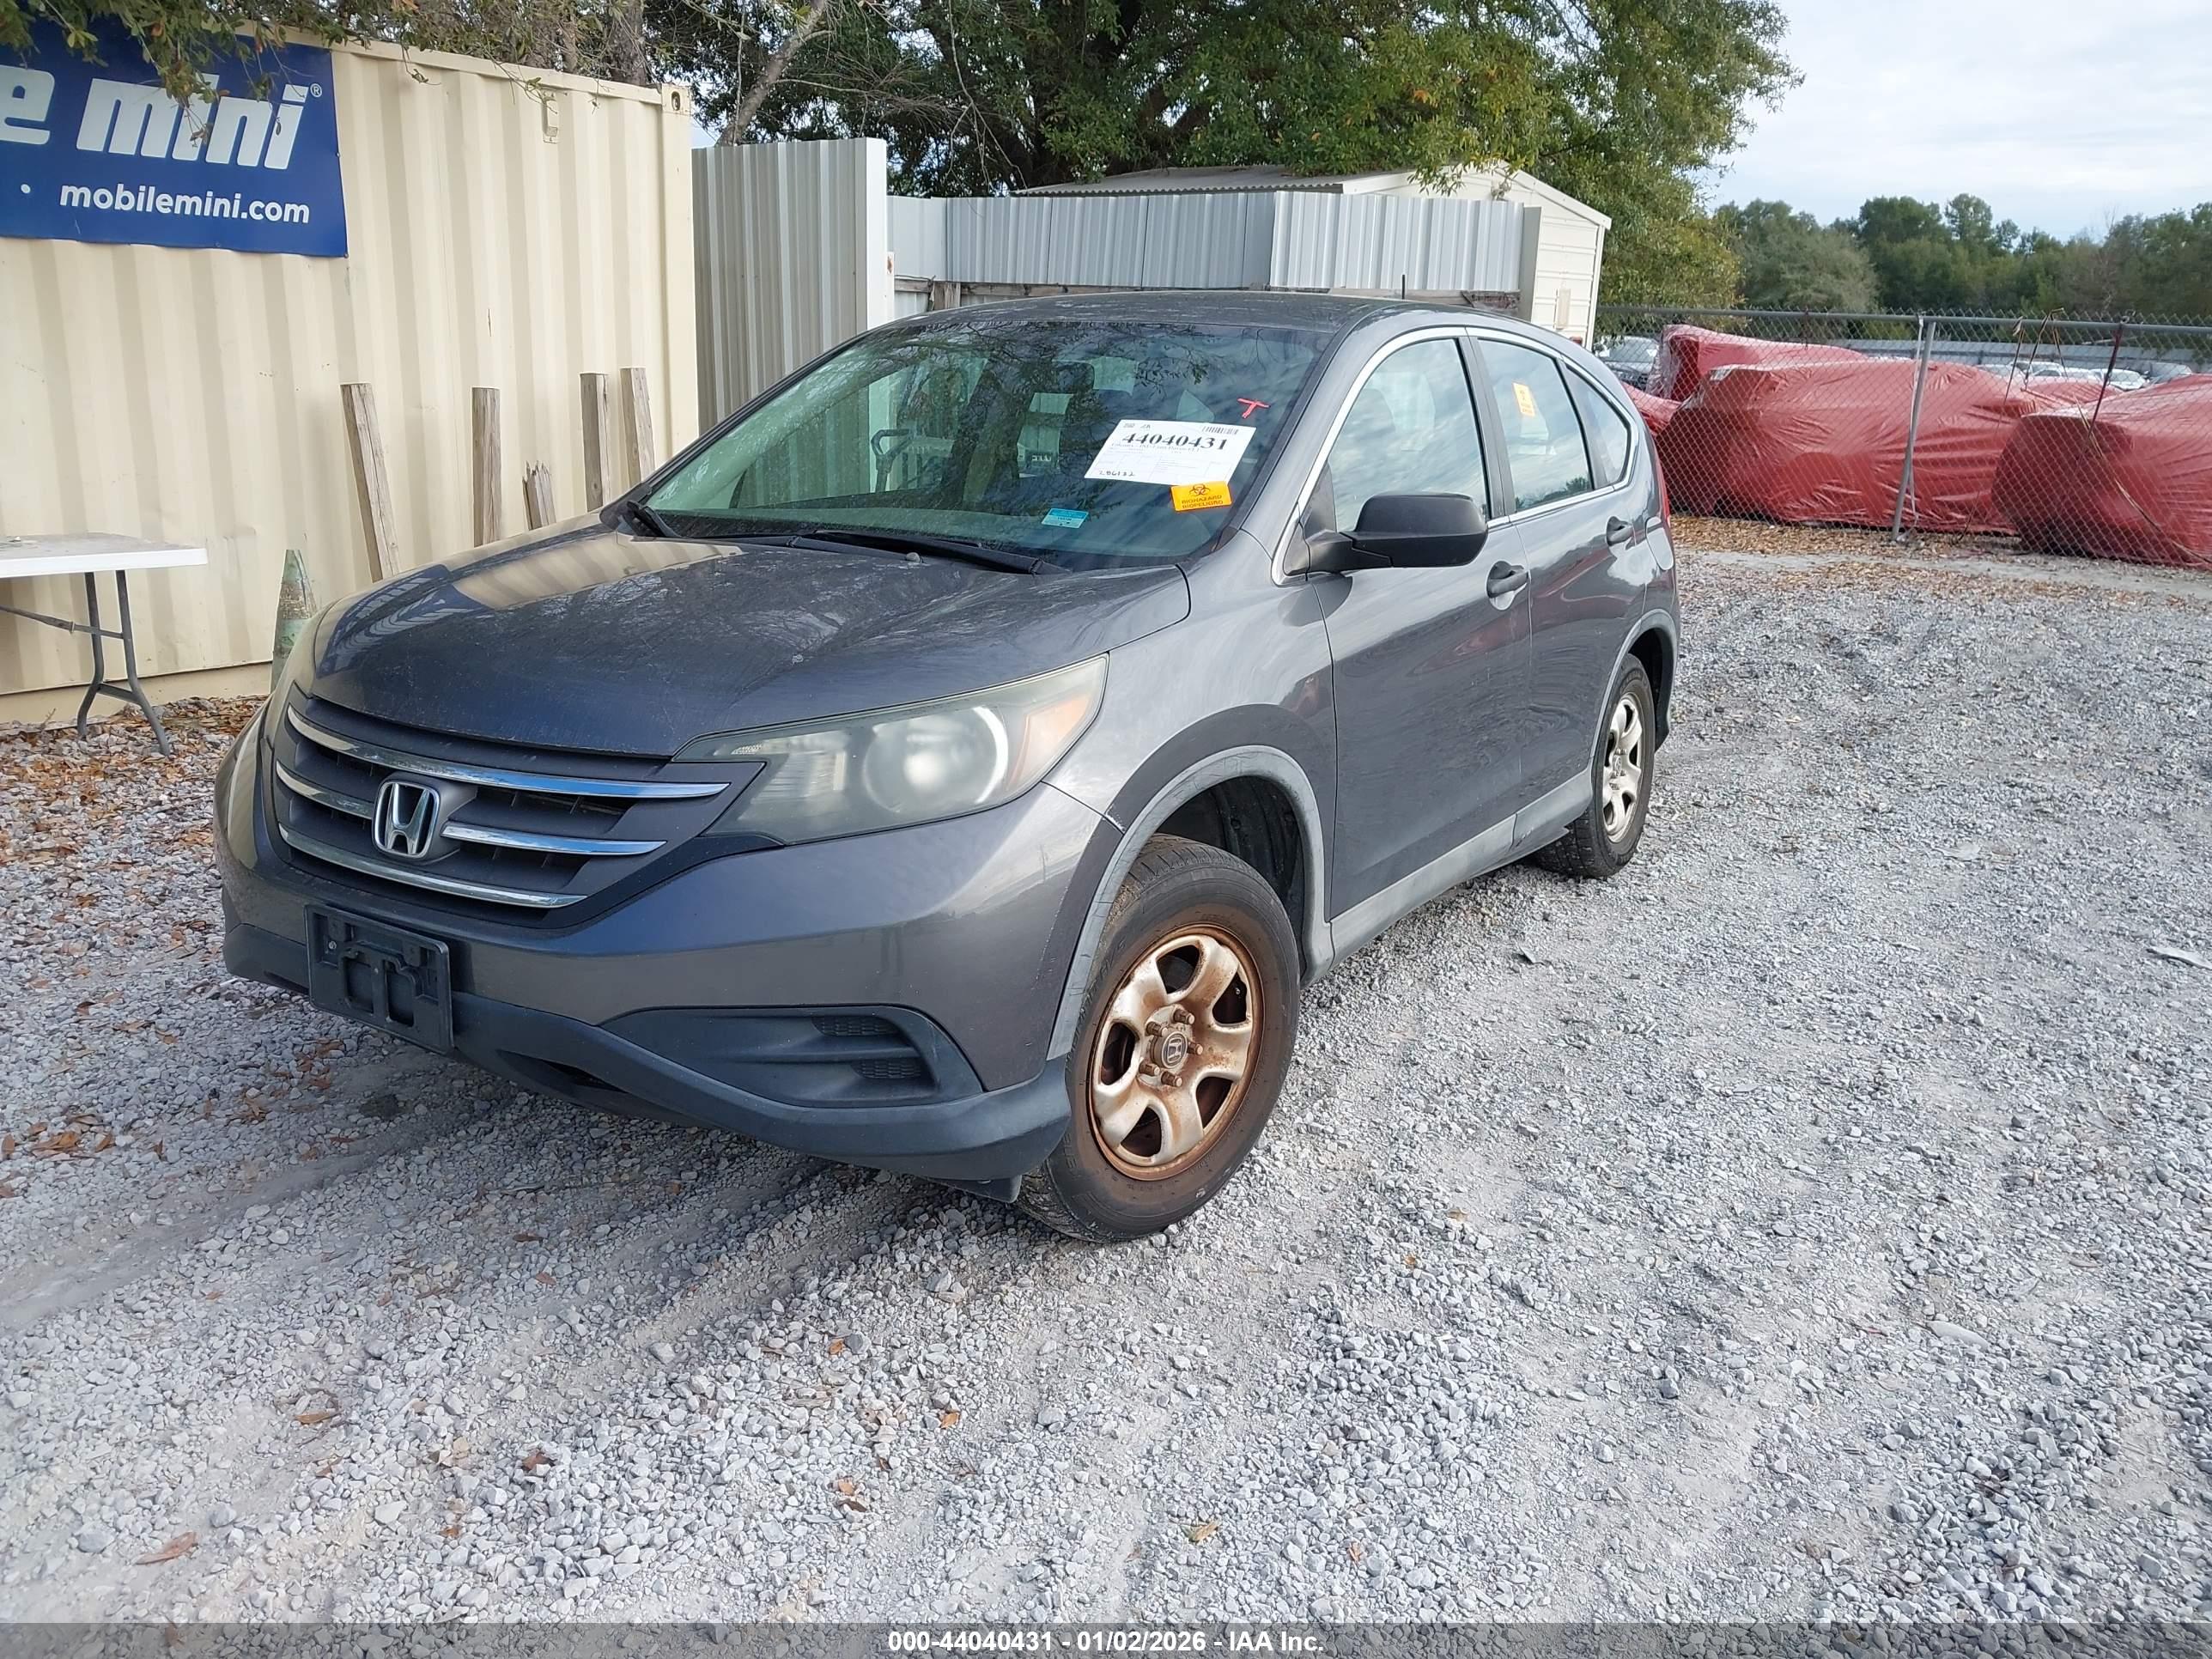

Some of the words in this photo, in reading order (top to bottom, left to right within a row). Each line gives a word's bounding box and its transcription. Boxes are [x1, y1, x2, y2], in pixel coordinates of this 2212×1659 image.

[59, 183, 310, 224] mobilemini.com
[1122, 432, 1228, 451] 44040431
[1182, 495, 1223, 505] BIOHAZARD
